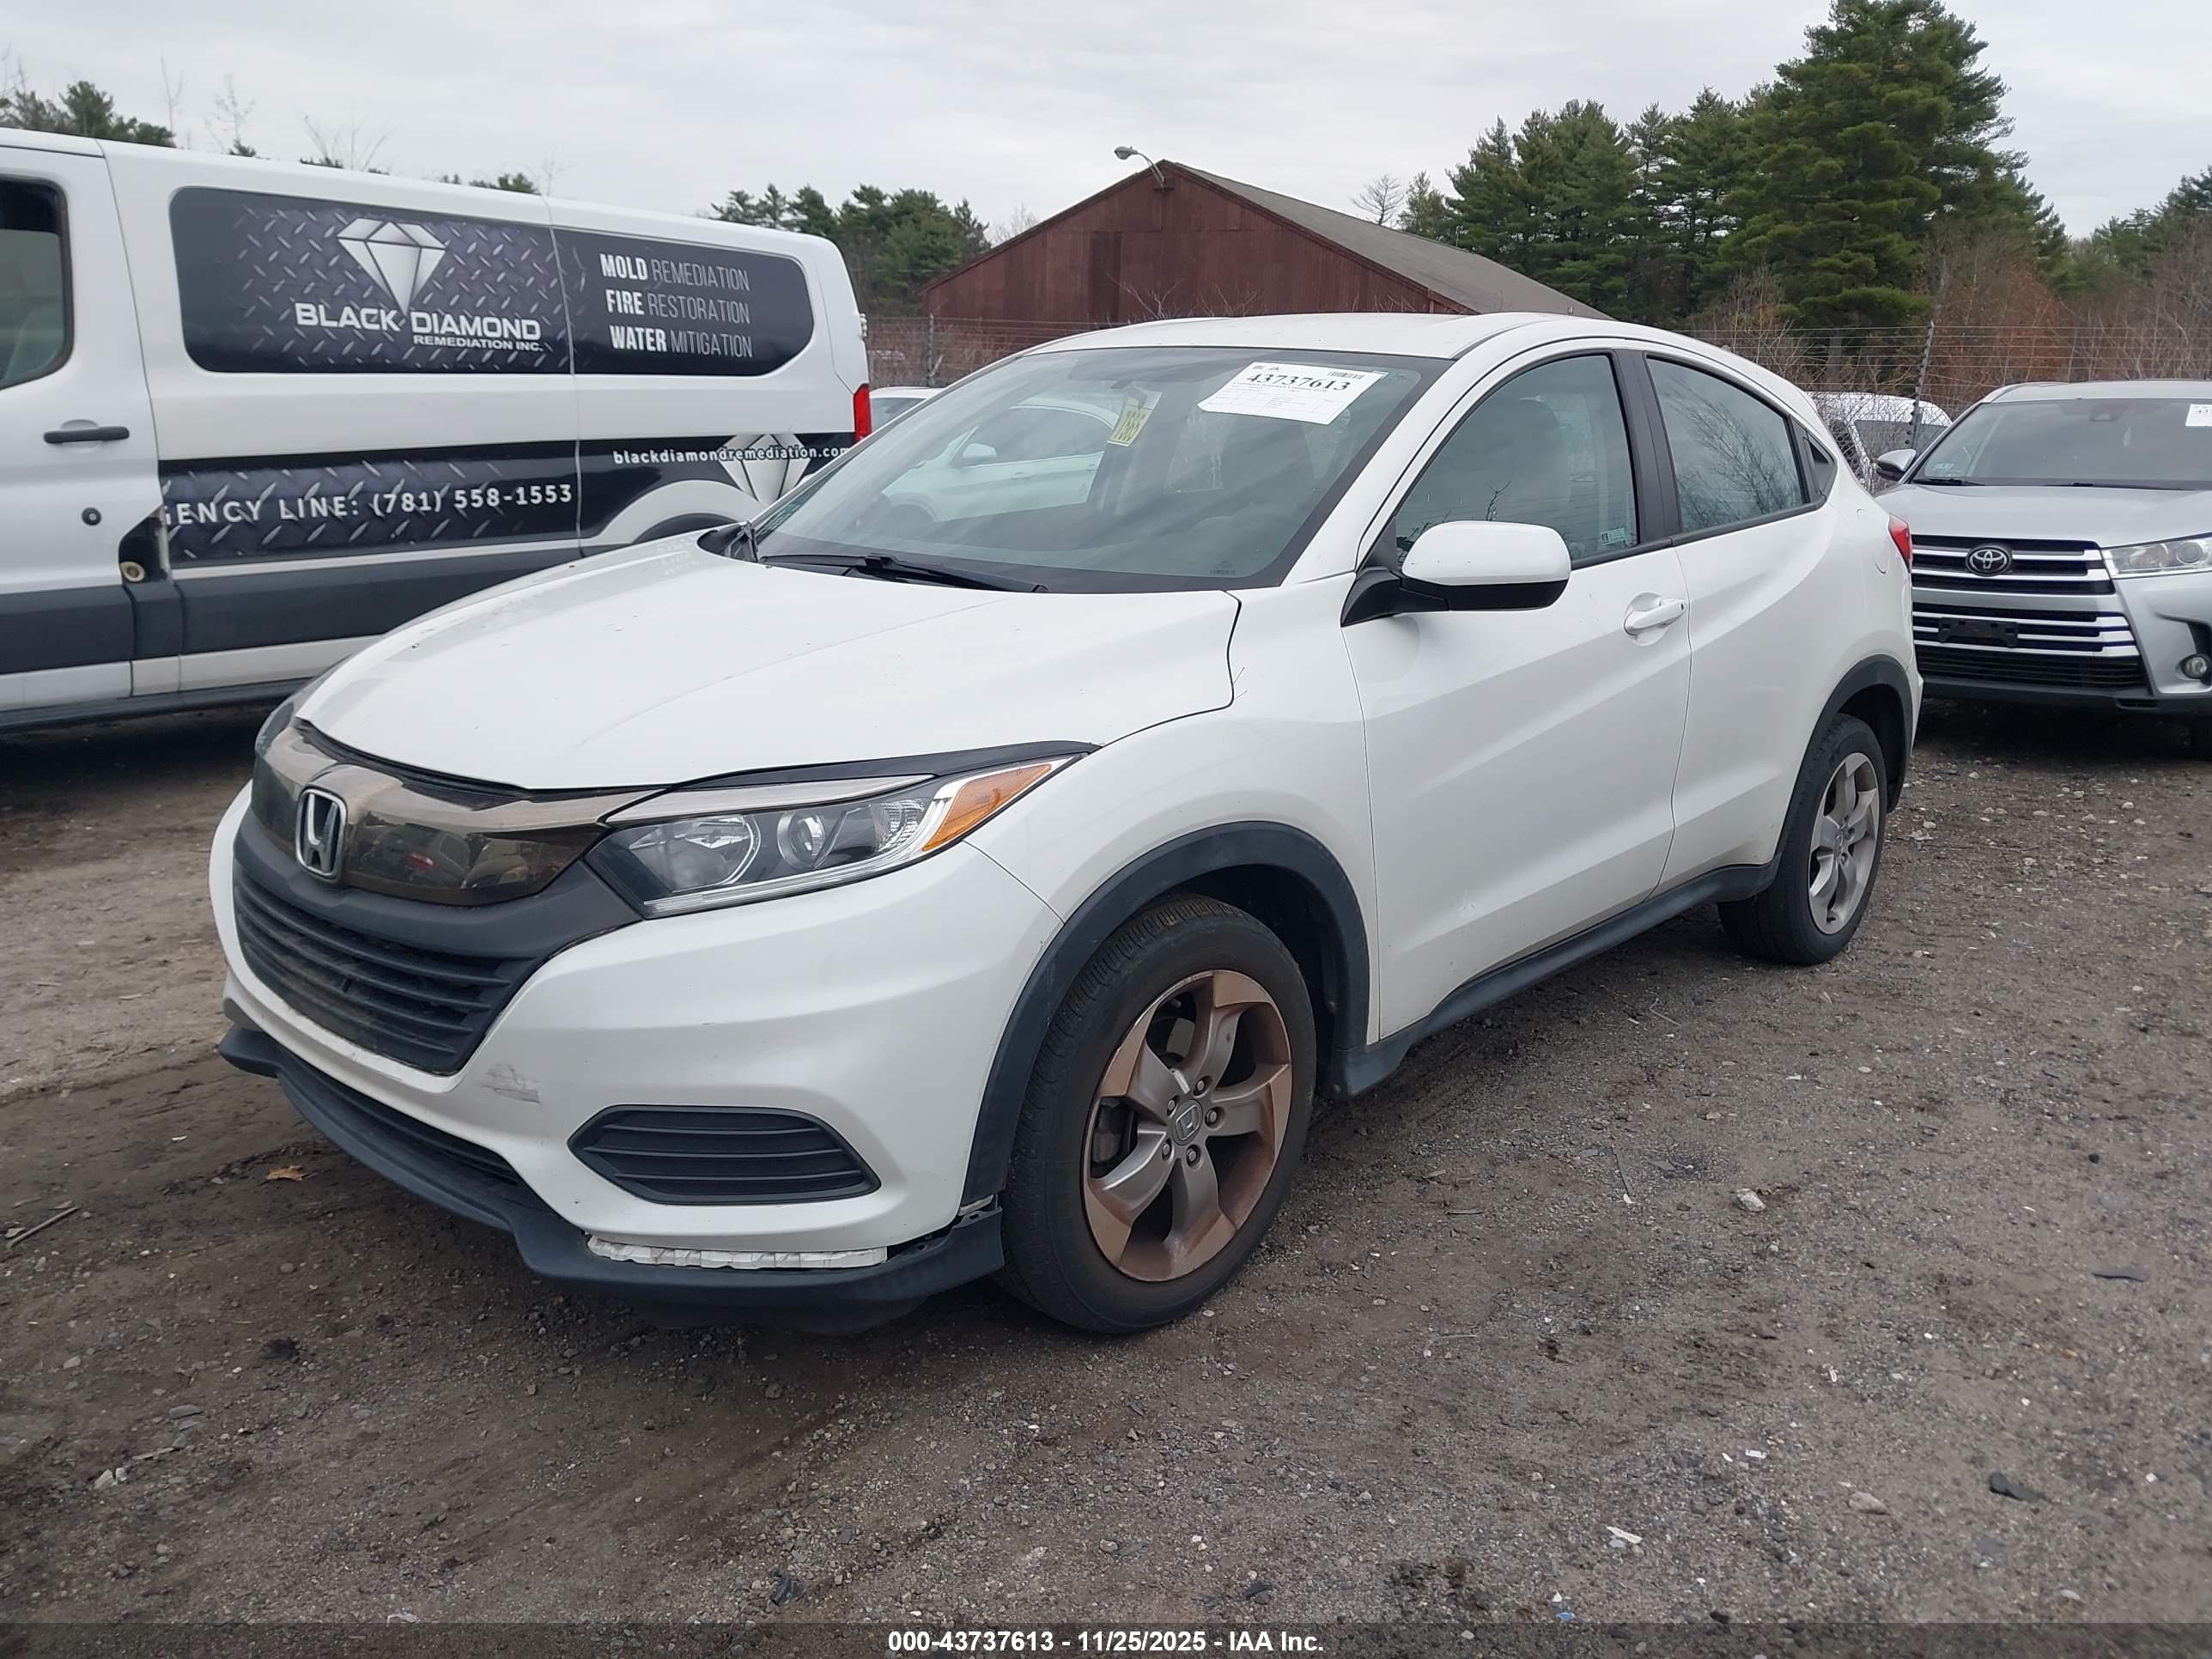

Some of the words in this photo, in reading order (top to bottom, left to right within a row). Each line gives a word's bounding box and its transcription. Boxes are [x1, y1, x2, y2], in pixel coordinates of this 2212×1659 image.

[599, 253, 648, 280] MOLD
[650, 258, 750, 291] REMEDIATION
[295, 302, 401, 331] BLACK
[410, 311, 541, 340] DIAMOND
[605, 289, 645, 315] FIRE
[647, 293, 750, 324] RESTORATION
[413, 334, 514, 351] REMEDIATION
[516, 340, 544, 352] INC.
[609, 325, 667, 352] WATER
[670, 329, 753, 358] MITIGATION
[1245, 373, 1351, 391] 43737613
[278, 495, 358, 520] LINE:
[373, 489, 441, 517] (781)
[453, 483, 573, 509] 558-1553
